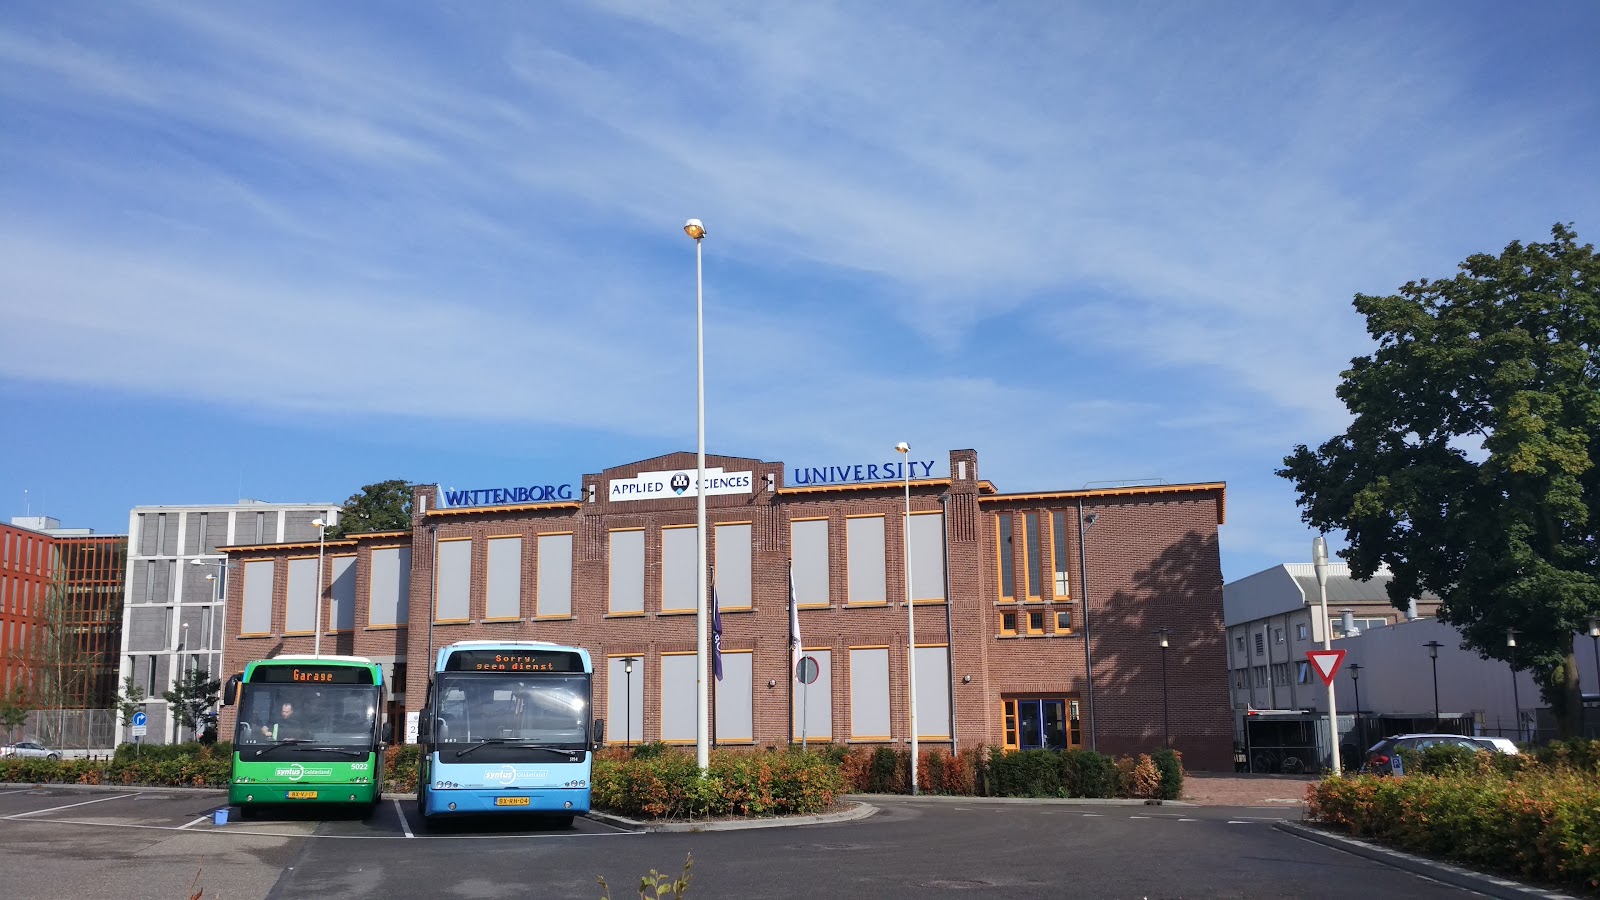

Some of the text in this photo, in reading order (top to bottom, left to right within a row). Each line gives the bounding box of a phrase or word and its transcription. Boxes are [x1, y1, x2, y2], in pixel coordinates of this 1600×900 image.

[794, 460, 935, 484] UNIVERSITY
[611, 482, 664, 495] APPLIED
[445, 484, 572, 506] WITTENBORG
[495, 654, 536, 663] Sorry,
[511, 662, 554, 671] dienst
[293, 668, 333, 681] Garage
[276, 768, 301, 776] syntus
[485, 771, 513, 779] syntus
